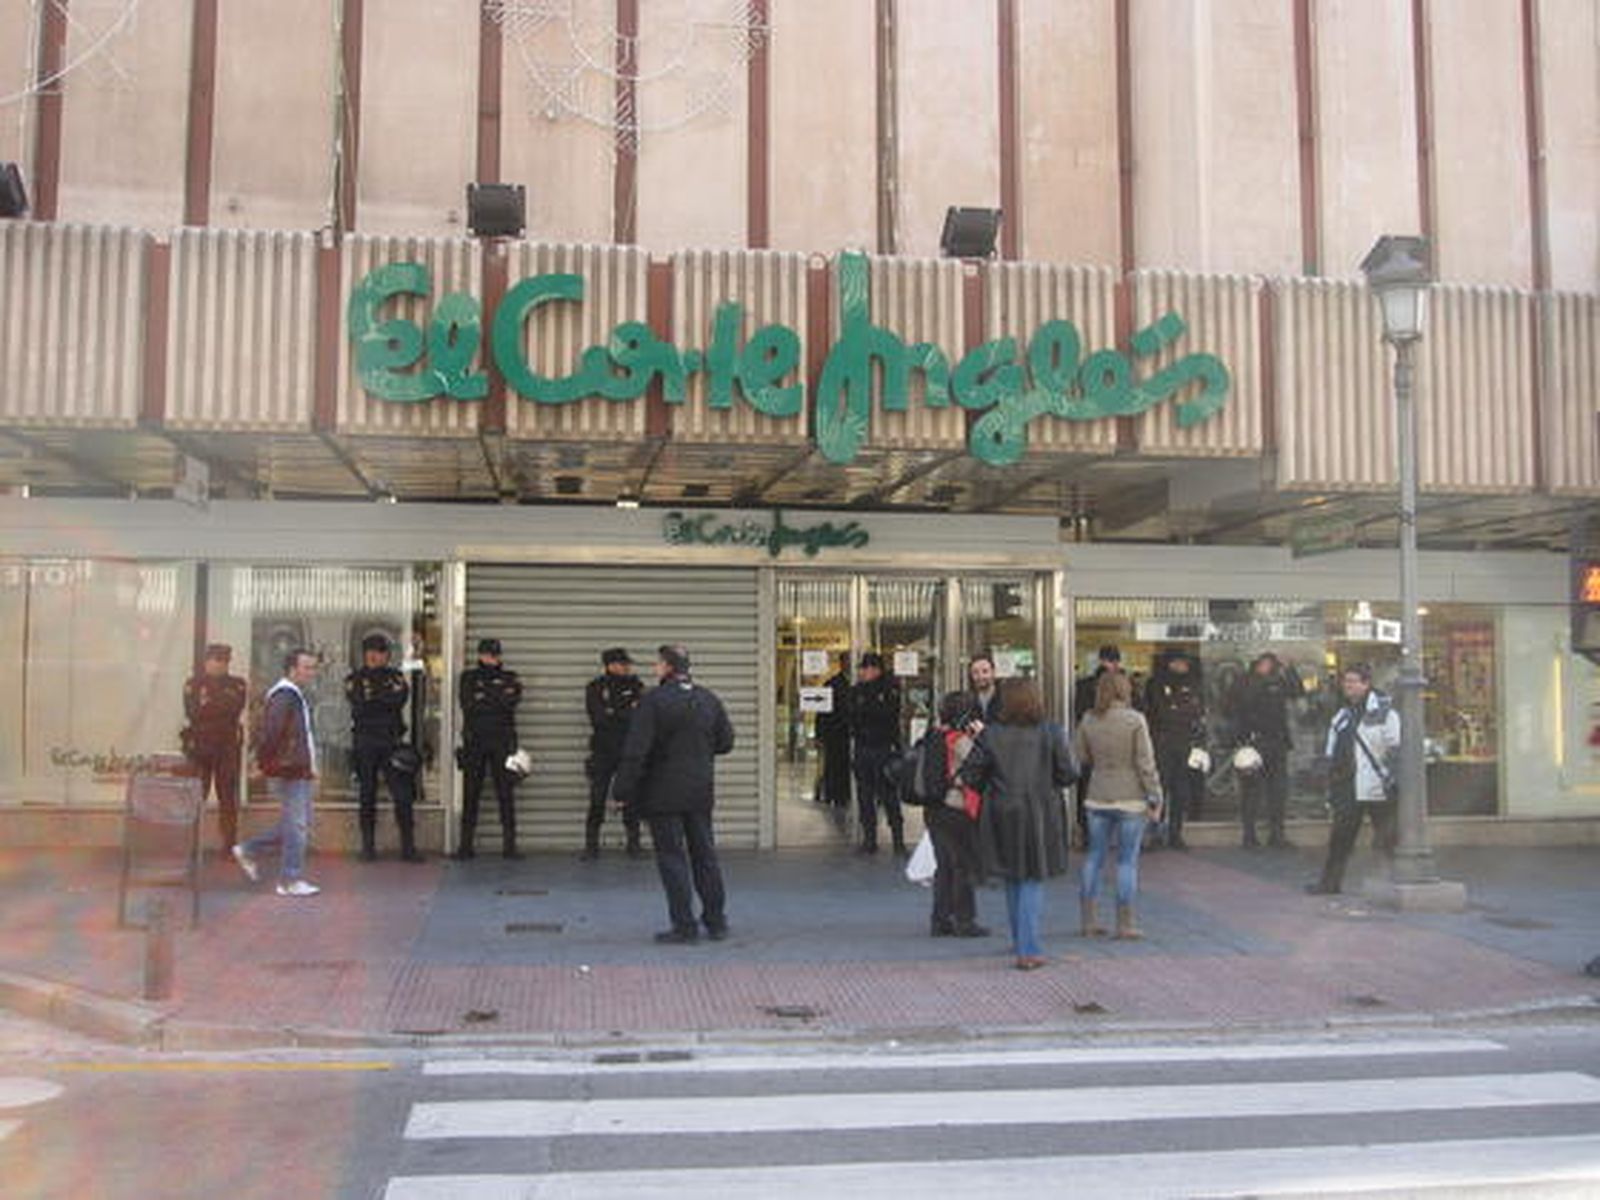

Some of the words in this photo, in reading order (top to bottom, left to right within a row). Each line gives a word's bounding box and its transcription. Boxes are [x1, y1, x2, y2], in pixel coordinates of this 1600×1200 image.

[348, 261, 489, 402] El
[491, 272, 803, 418] Corte
[816, 249, 1229, 467] Inglés
